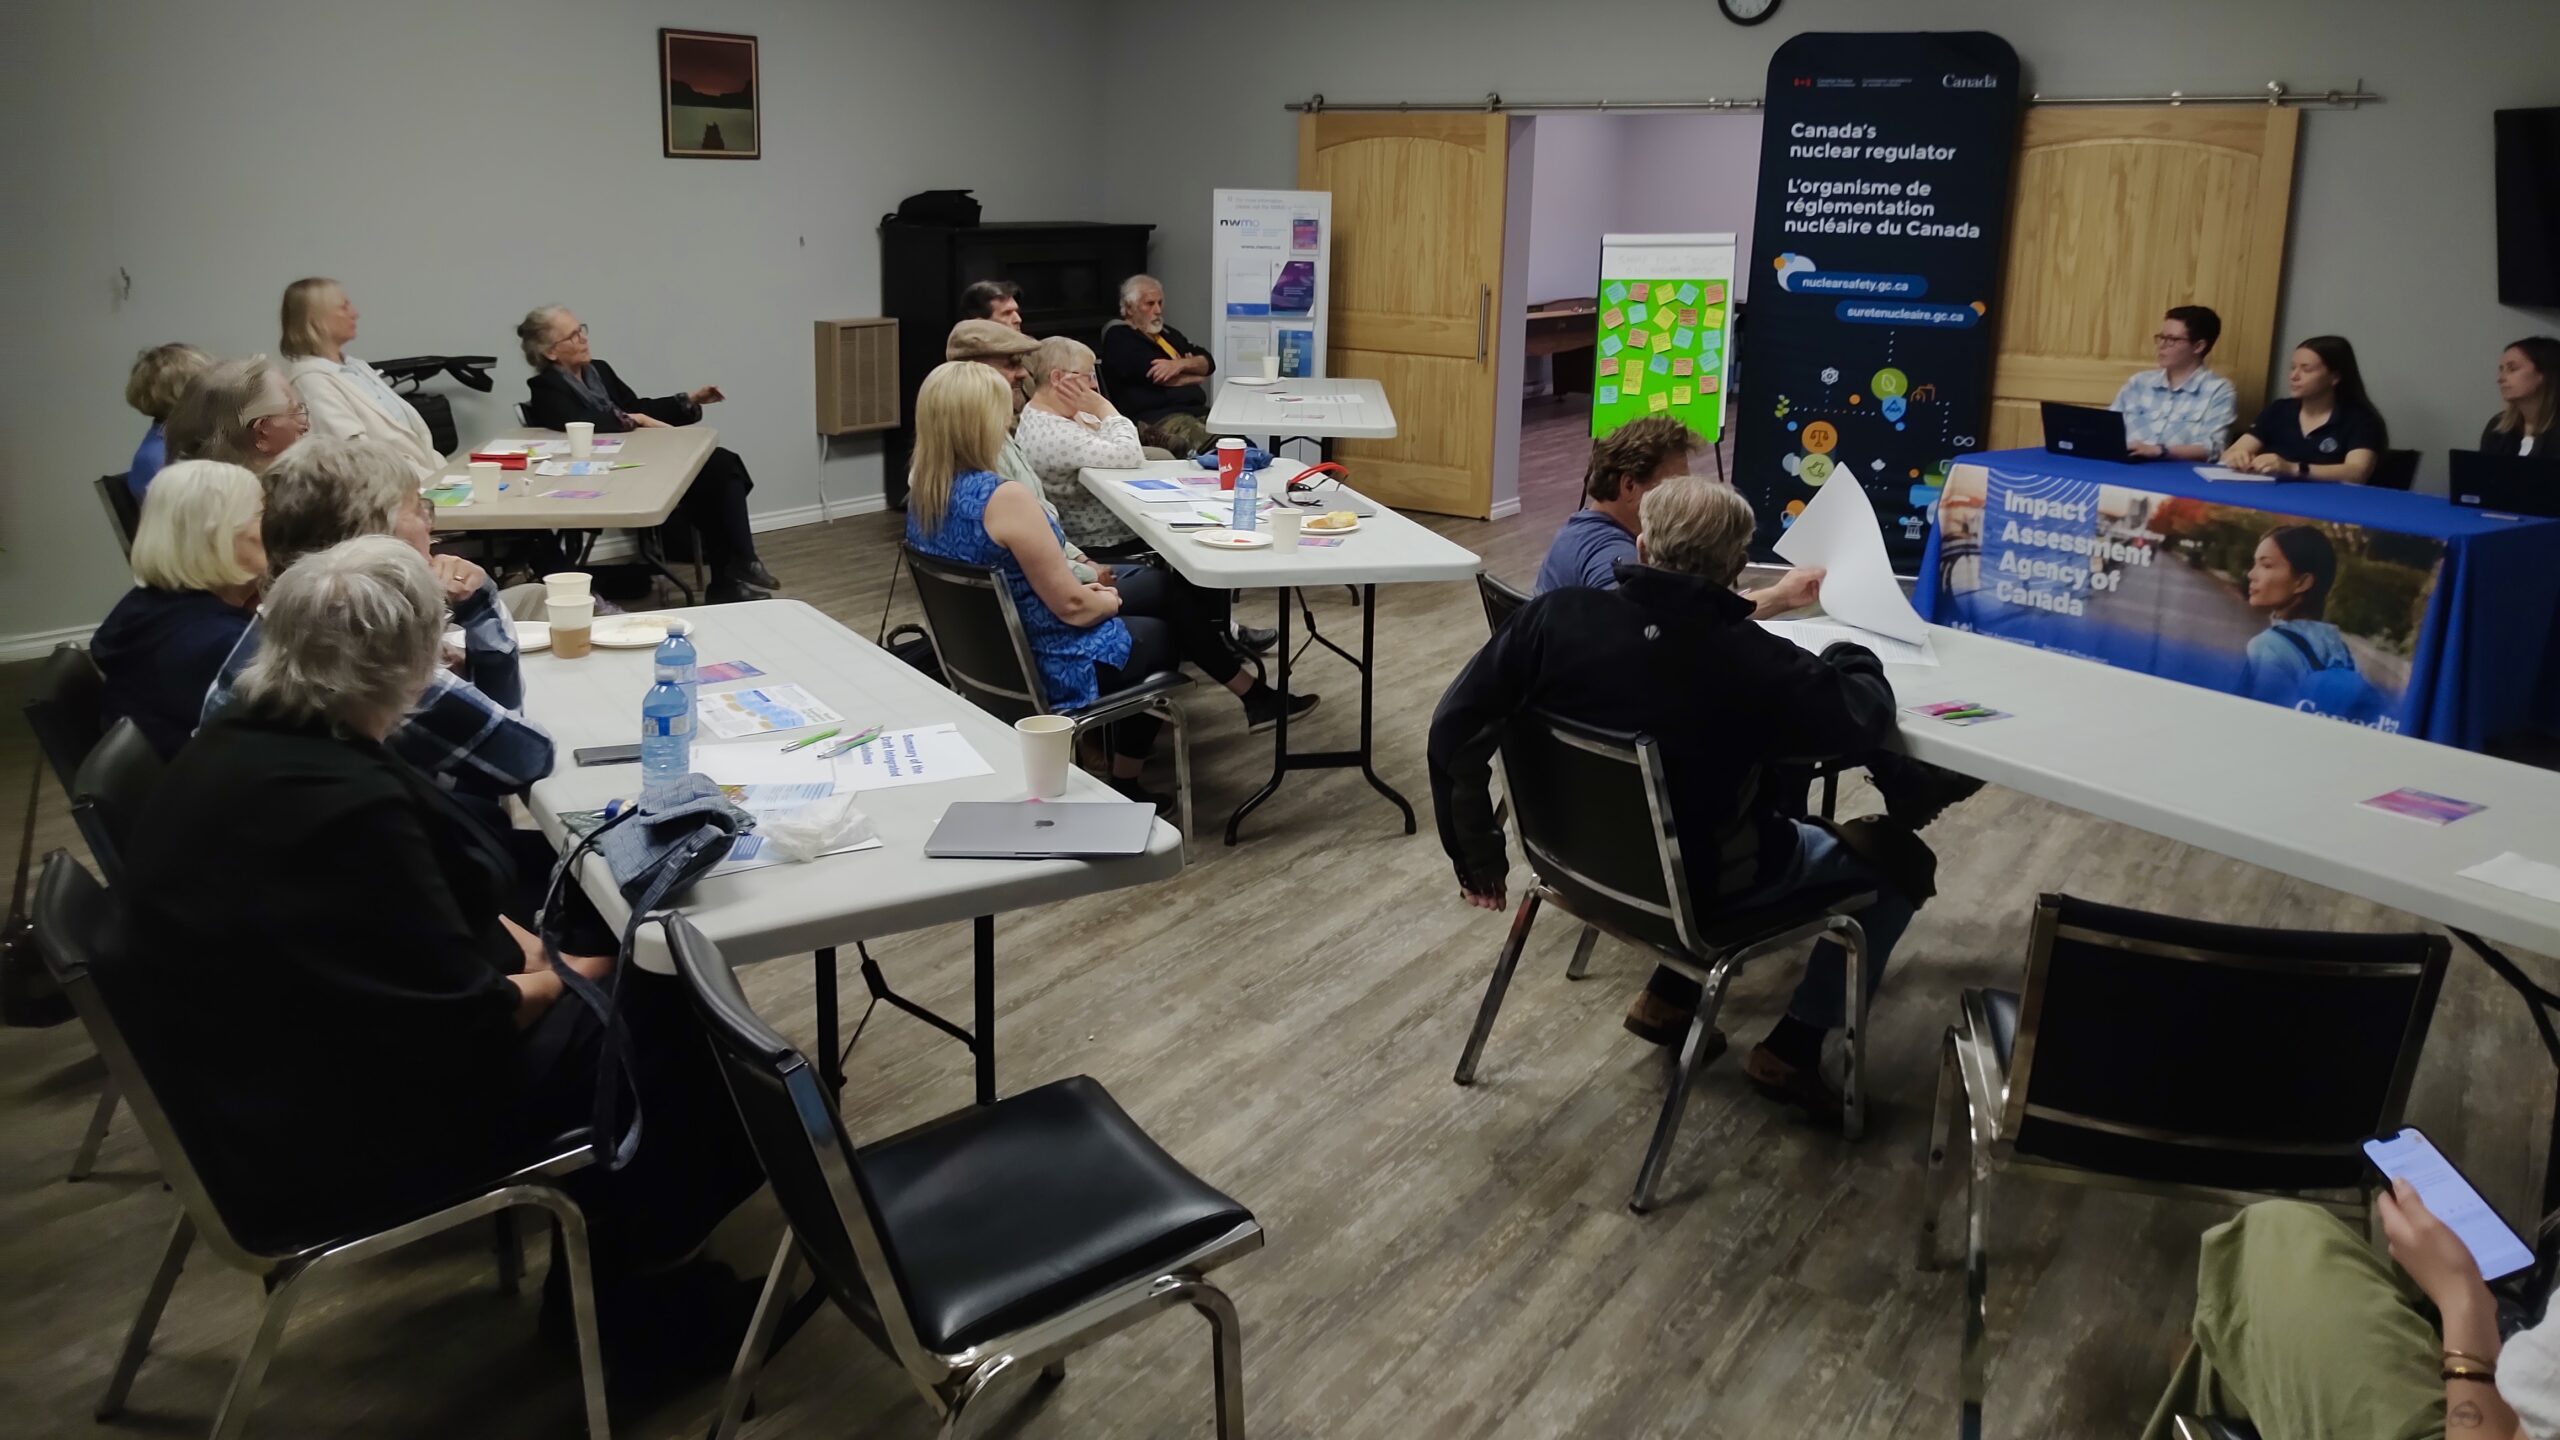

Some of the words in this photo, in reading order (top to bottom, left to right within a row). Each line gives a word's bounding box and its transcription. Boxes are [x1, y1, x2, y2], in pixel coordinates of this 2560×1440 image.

[1942, 73, 1998, 88] Canada
[1791, 122, 1877, 139] Canada's
[1789, 142, 1861, 158] nuclear
[1865, 144, 1957, 163] regulator
[1787, 178, 1902, 197] L'organisme
[1906, 180, 1932, 196] de
[1785, 197, 1935, 217] réglementation
[1220, 219, 1260, 227] nwmo
[1784, 217, 1872, 234] nucléaire
[1876, 219, 1902, 235] du
[1906, 220, 1981, 238] Canada
[1802, 277, 1909, 293] nuclearsafety.gc.ca
[1847, 307, 1965, 323] suretenucleaire.gc.ca
[2004, 489, 2088, 523] Impact
[2001, 520, 2153, 567] Assessment
[1999, 550, 2088, 591] Agency
[2091, 570, 2121, 592] of
[1997, 580, 2084, 617] Canada
